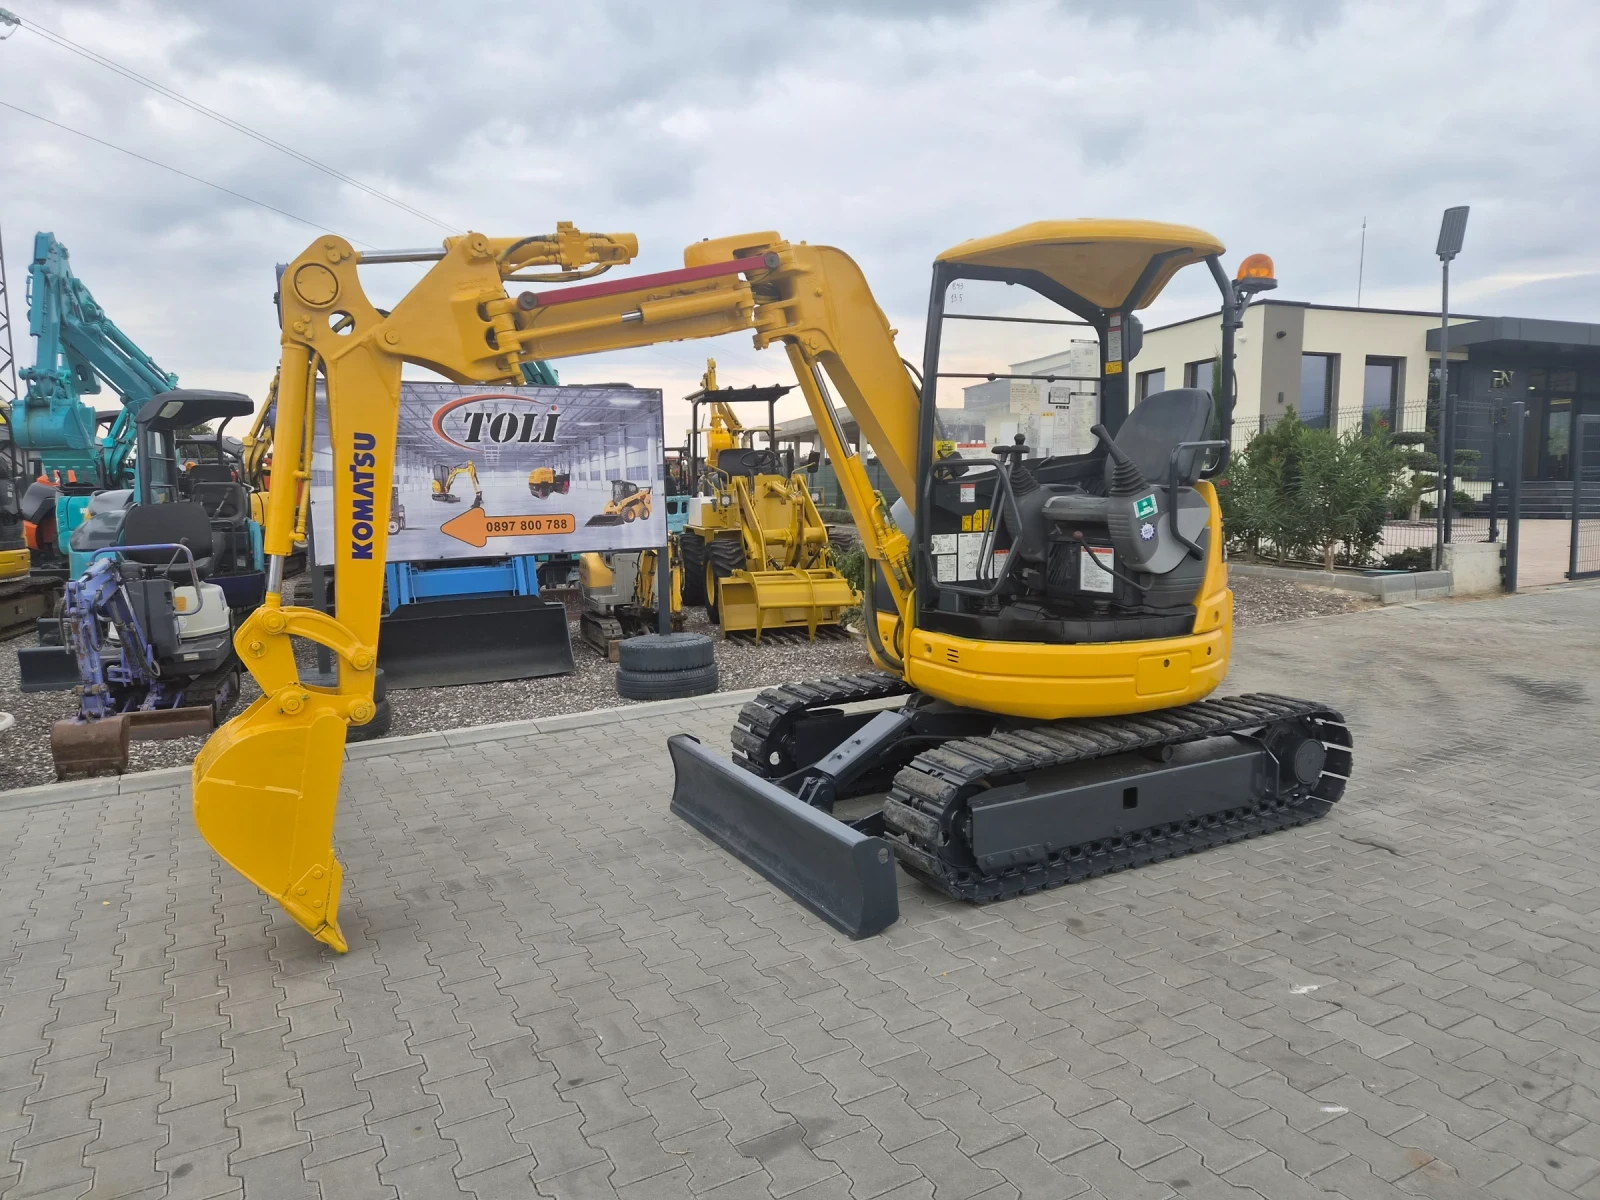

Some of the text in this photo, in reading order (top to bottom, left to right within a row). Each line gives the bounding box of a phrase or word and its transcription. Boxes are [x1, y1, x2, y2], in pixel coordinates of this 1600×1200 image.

[350, 432, 376, 560] KOMATSU
[486, 519, 568, 532] 0897 800 788
